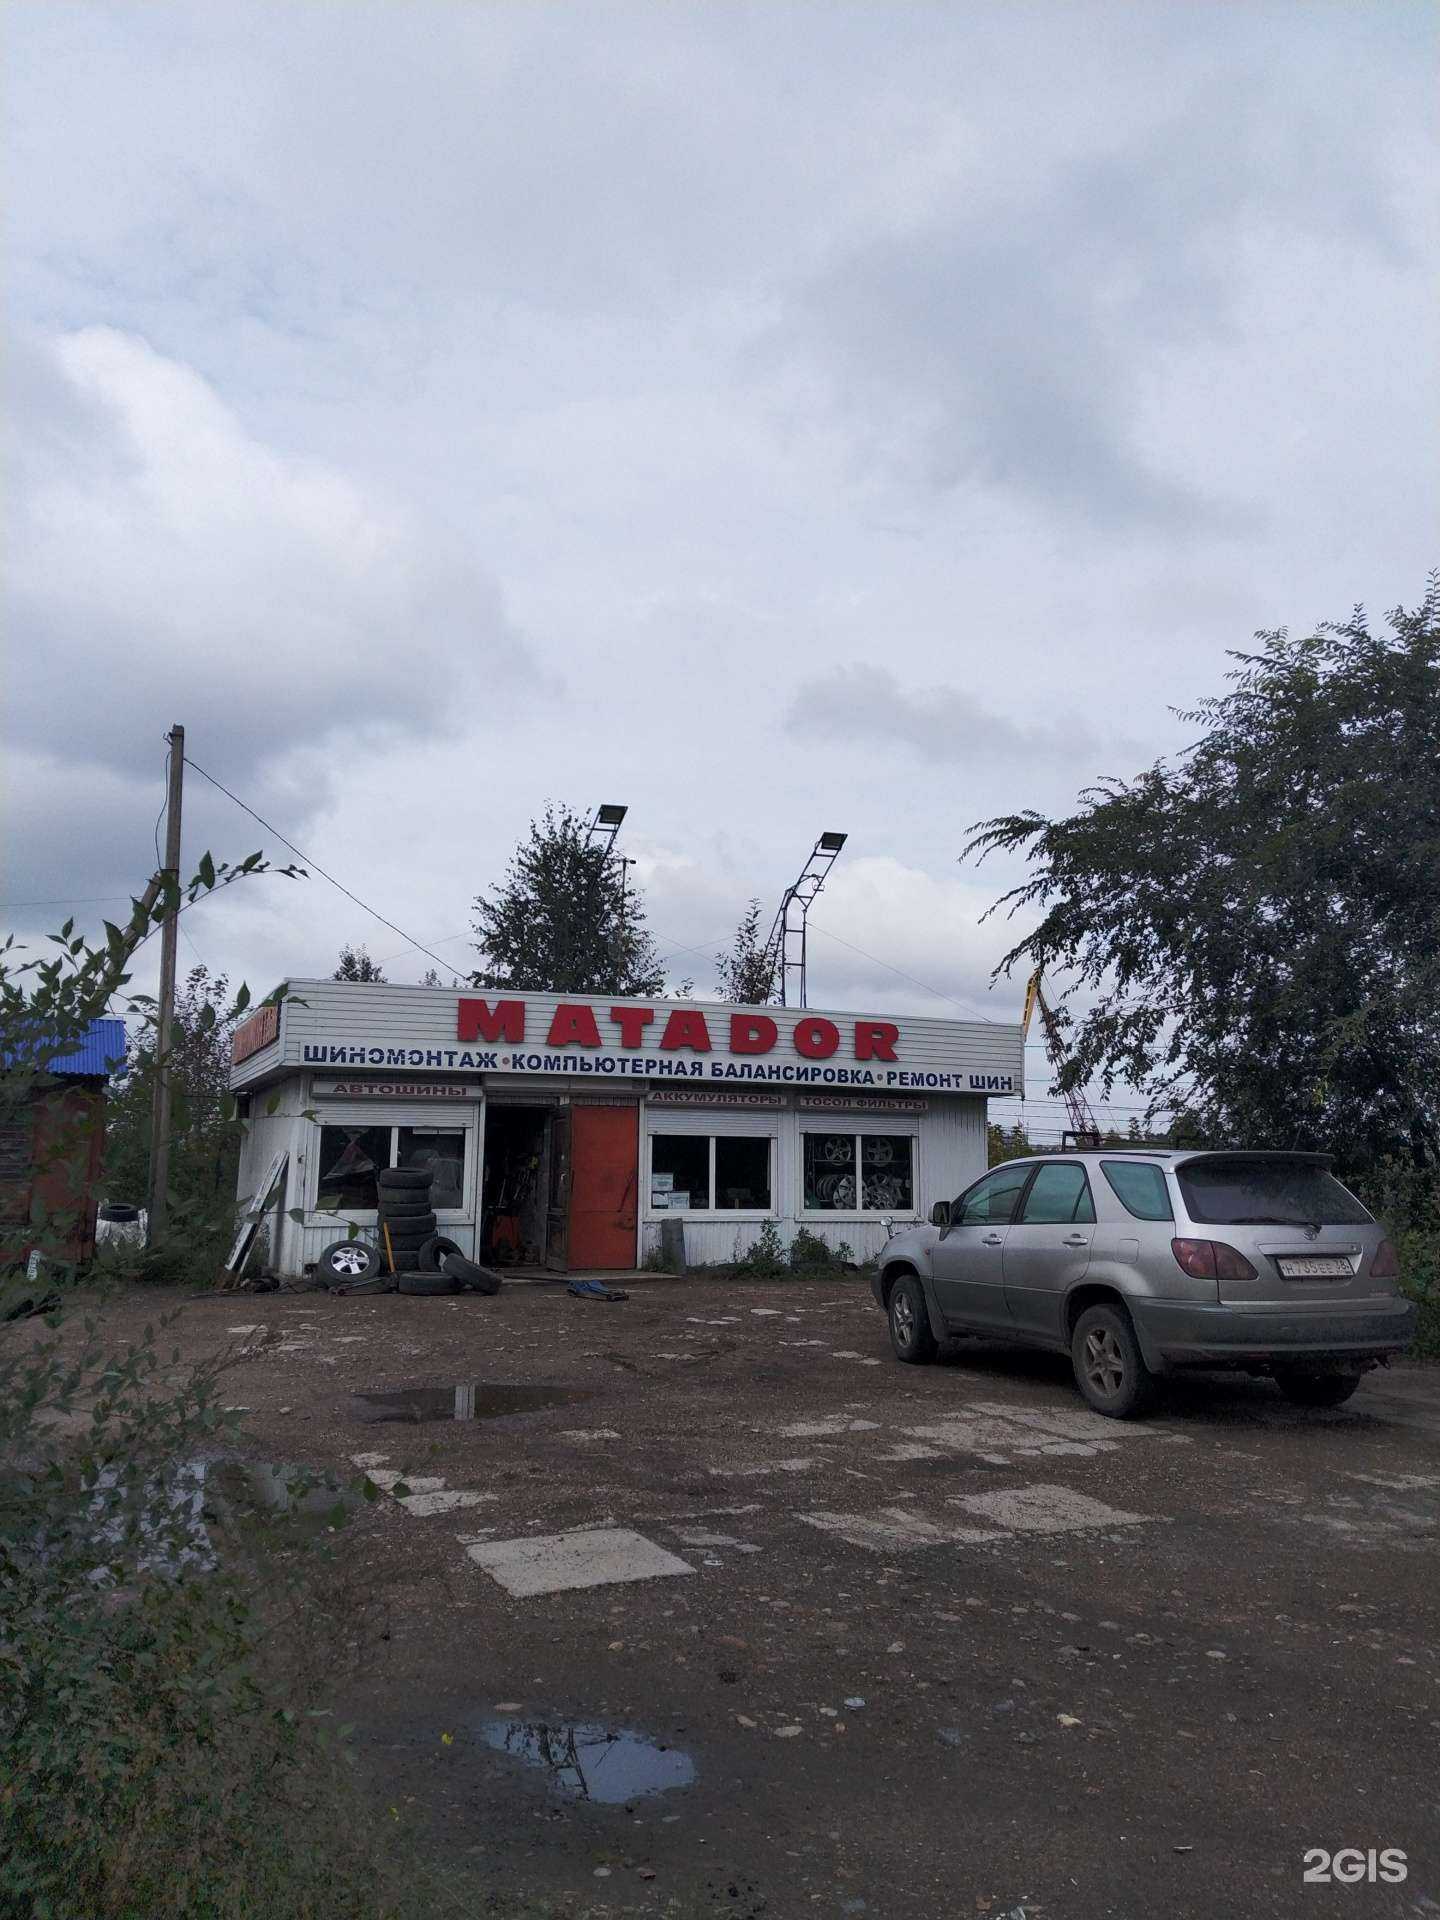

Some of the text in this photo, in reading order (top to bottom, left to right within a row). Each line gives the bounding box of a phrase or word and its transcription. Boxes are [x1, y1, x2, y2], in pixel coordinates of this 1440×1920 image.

[457, 998, 900, 1062] MATADOR
[303, 1045, 1013, 1091] ШИНОМОНТАЖ КОМПЬЮТЕРНАЯ БАЛАНСИРОВКА РЕМОНТ ШИН
[333, 1083, 467, 1097] АВТОШИНЫ
[652, 1091, 782, 1105] АККУМУЛЯТОРЫ
[855, 1099, 928, 1110] ФИЛЬТРЫ
